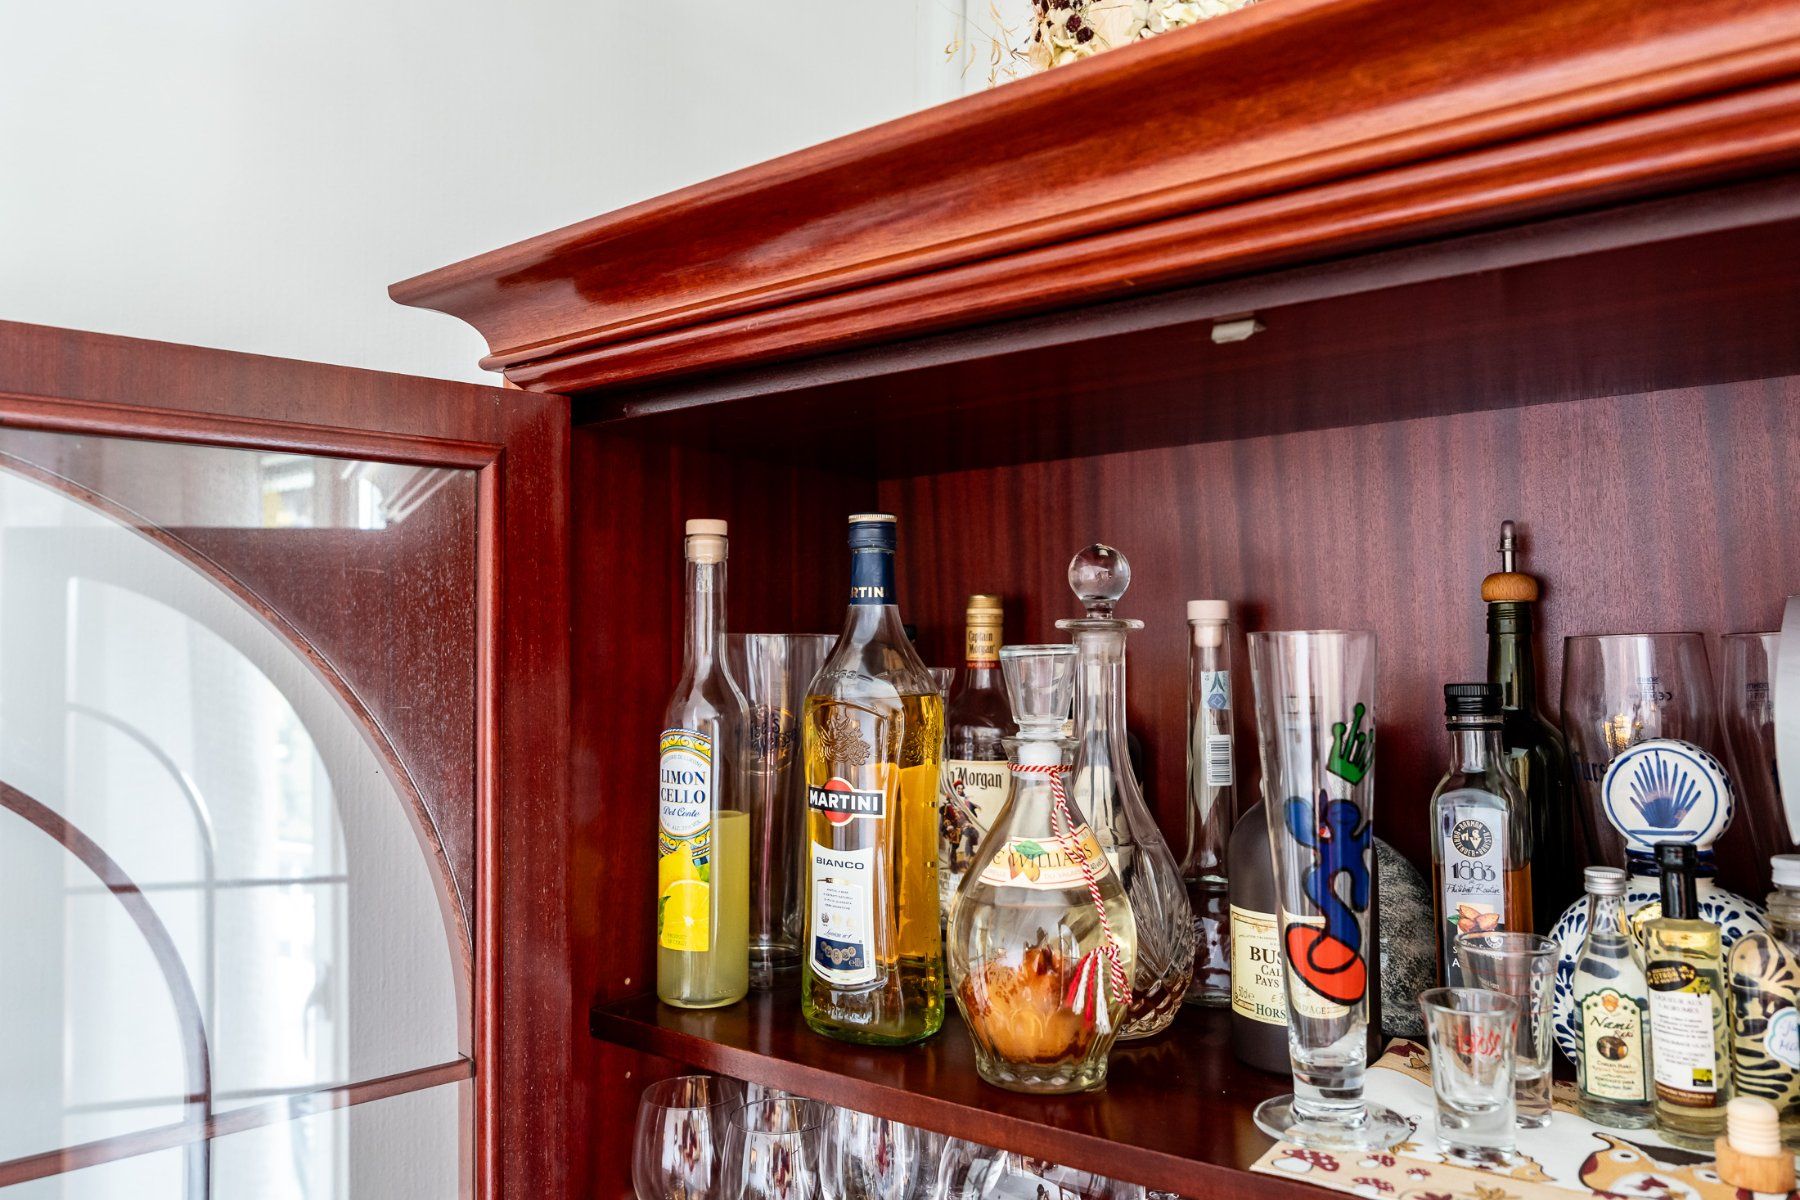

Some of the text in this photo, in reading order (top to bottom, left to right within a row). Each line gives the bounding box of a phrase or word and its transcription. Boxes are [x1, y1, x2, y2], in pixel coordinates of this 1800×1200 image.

[661, 769, 706, 785] LIMON
[956, 767, 1002, 790] Morgan
[661, 787, 706, 804] CELLO
[809, 789, 879, 811] MARTINI
[663, 806, 676, 816] Del
[816, 856, 865, 870] BIANCO
[1451, 860, 1497, 882] 1883
[1255, 974, 1280, 988] PAYS
[1255, 1003, 1287, 1019] HORS
